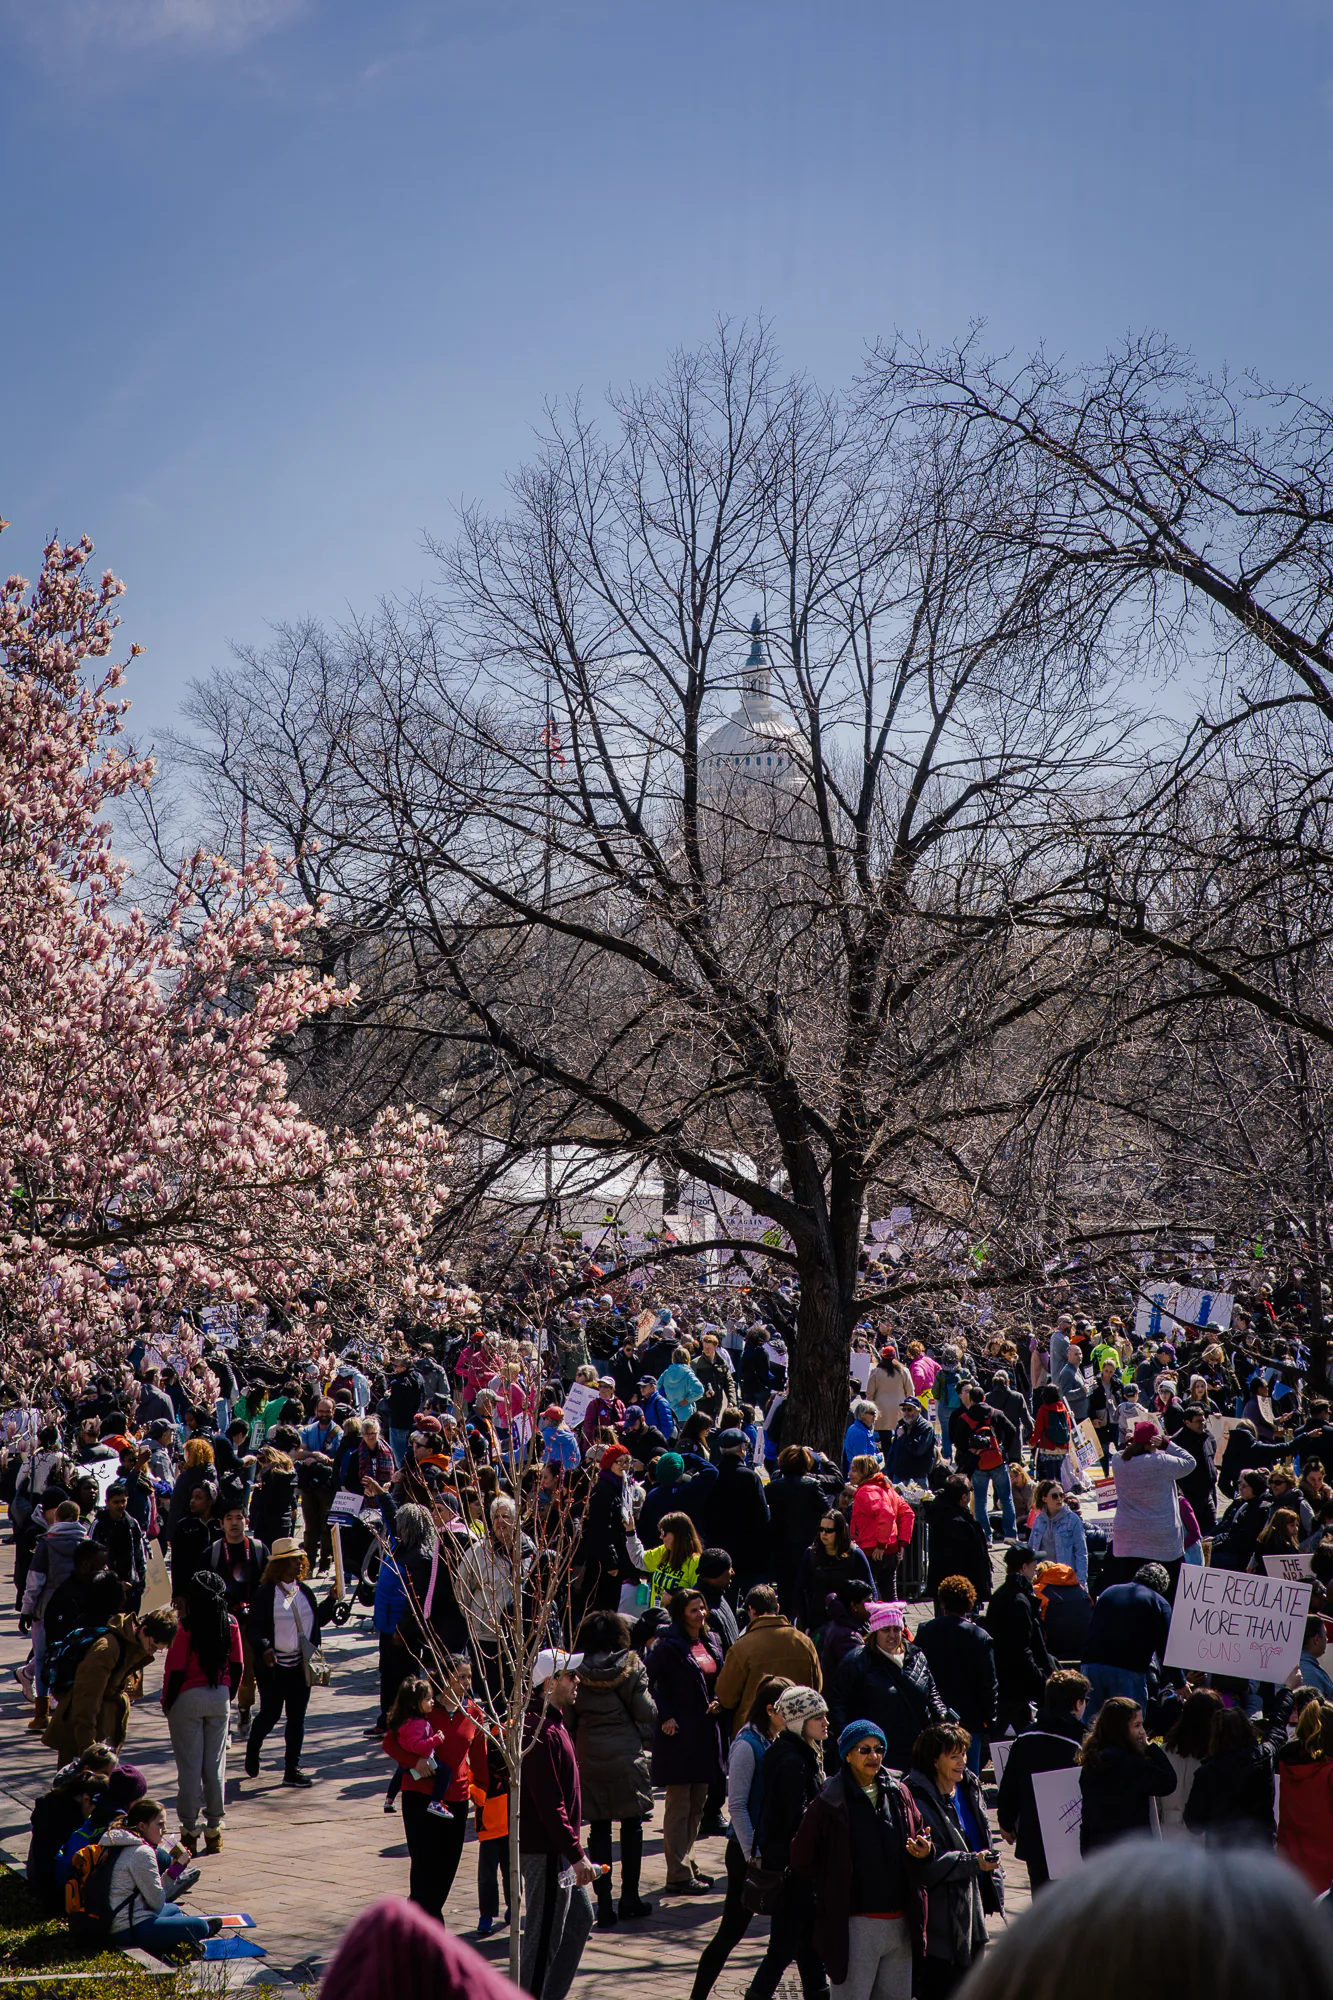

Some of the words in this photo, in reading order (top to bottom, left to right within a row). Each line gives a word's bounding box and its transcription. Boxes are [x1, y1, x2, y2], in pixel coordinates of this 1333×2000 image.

[1280, 1559, 1302, 1572] THE
[1183, 1569, 1221, 1604] WE
[1221, 1575, 1311, 1618] REGULATE
[1189, 1608, 1243, 1636] MORE
[1244, 1614, 1292, 1643] THAN
[1197, 1639, 1242, 1663] GUNS
